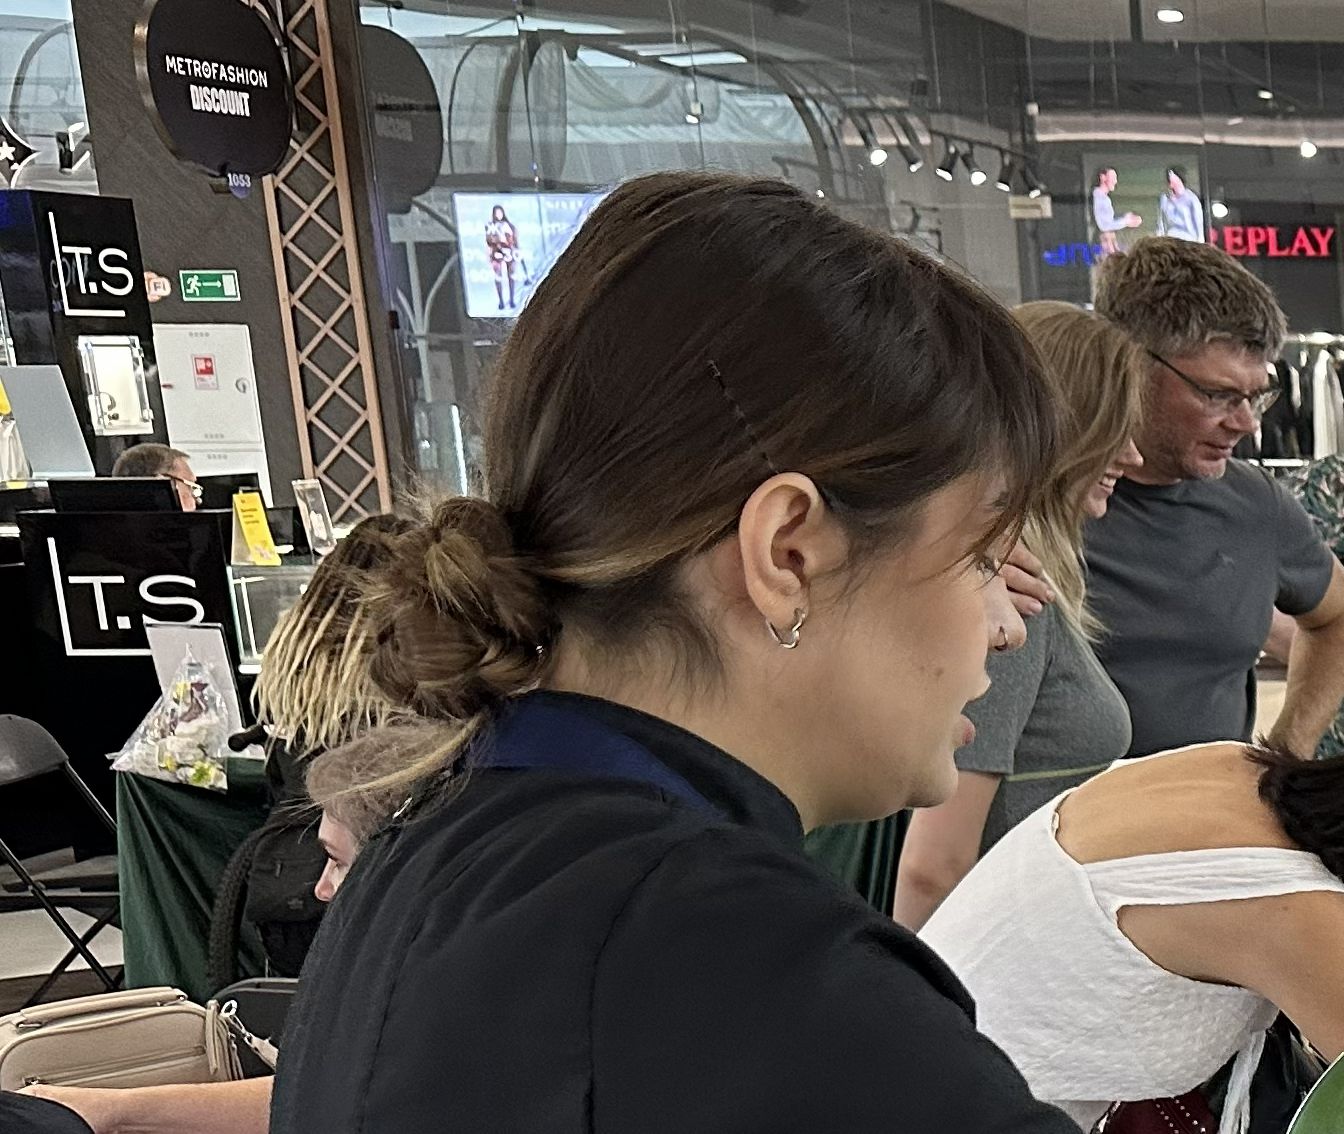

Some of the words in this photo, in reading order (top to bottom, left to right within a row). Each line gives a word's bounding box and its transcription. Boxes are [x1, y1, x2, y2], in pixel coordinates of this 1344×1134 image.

[165, 55, 268, 88] METROFASHION
[190, 84, 250, 117] DISCOUNT
[228, 172, 251, 188] 1053
